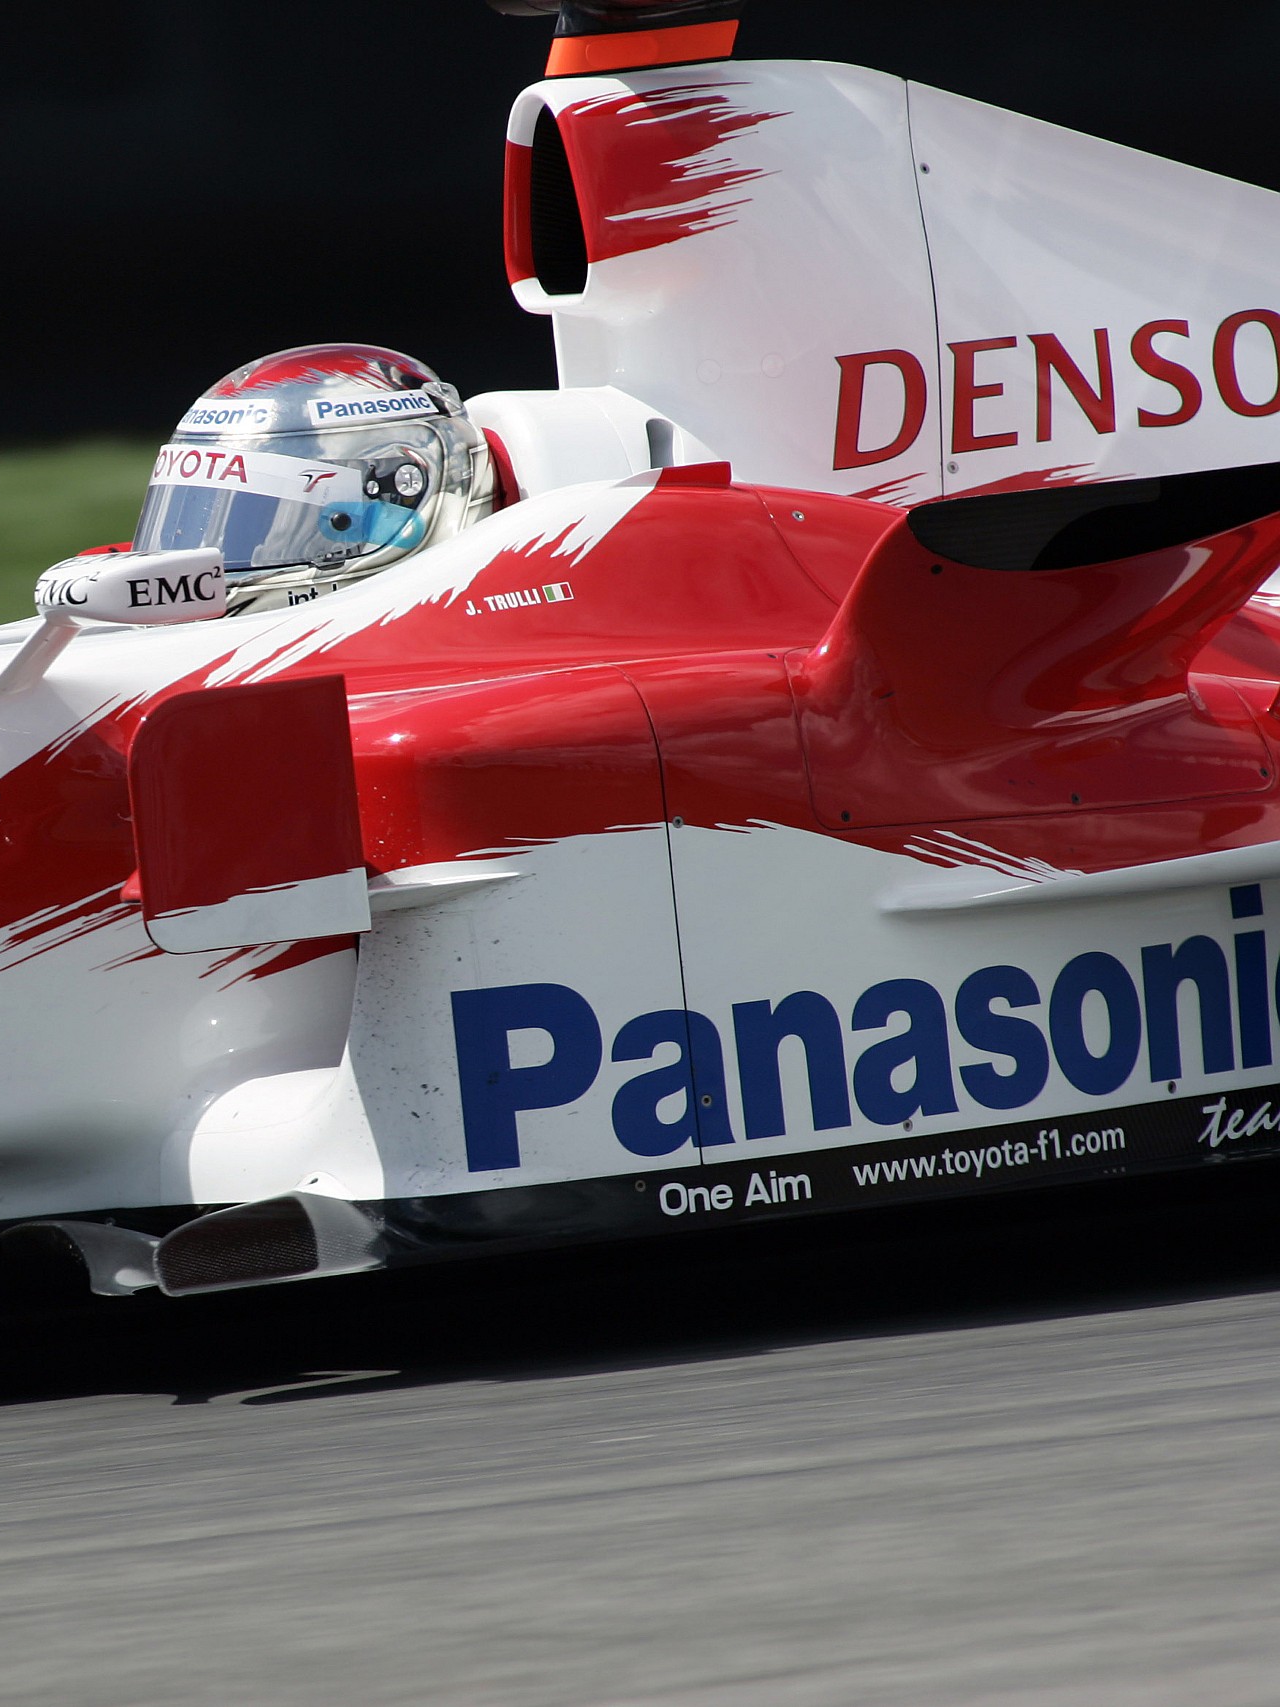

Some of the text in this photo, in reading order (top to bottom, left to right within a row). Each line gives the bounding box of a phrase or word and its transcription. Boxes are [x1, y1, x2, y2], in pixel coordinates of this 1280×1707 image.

[316, 393, 431, 419] Panasonic
[833, 309, 1280, 471] DENSO
[465, 588, 542, 616] J. TRULLI
[450, 883, 1280, 1173] Panasoni
[1197, 1096, 1280, 1148] tea
[852, 1127, 1126, 1186] www.toyota-f1.com
[659, 1170, 813, 1216] One Aim
